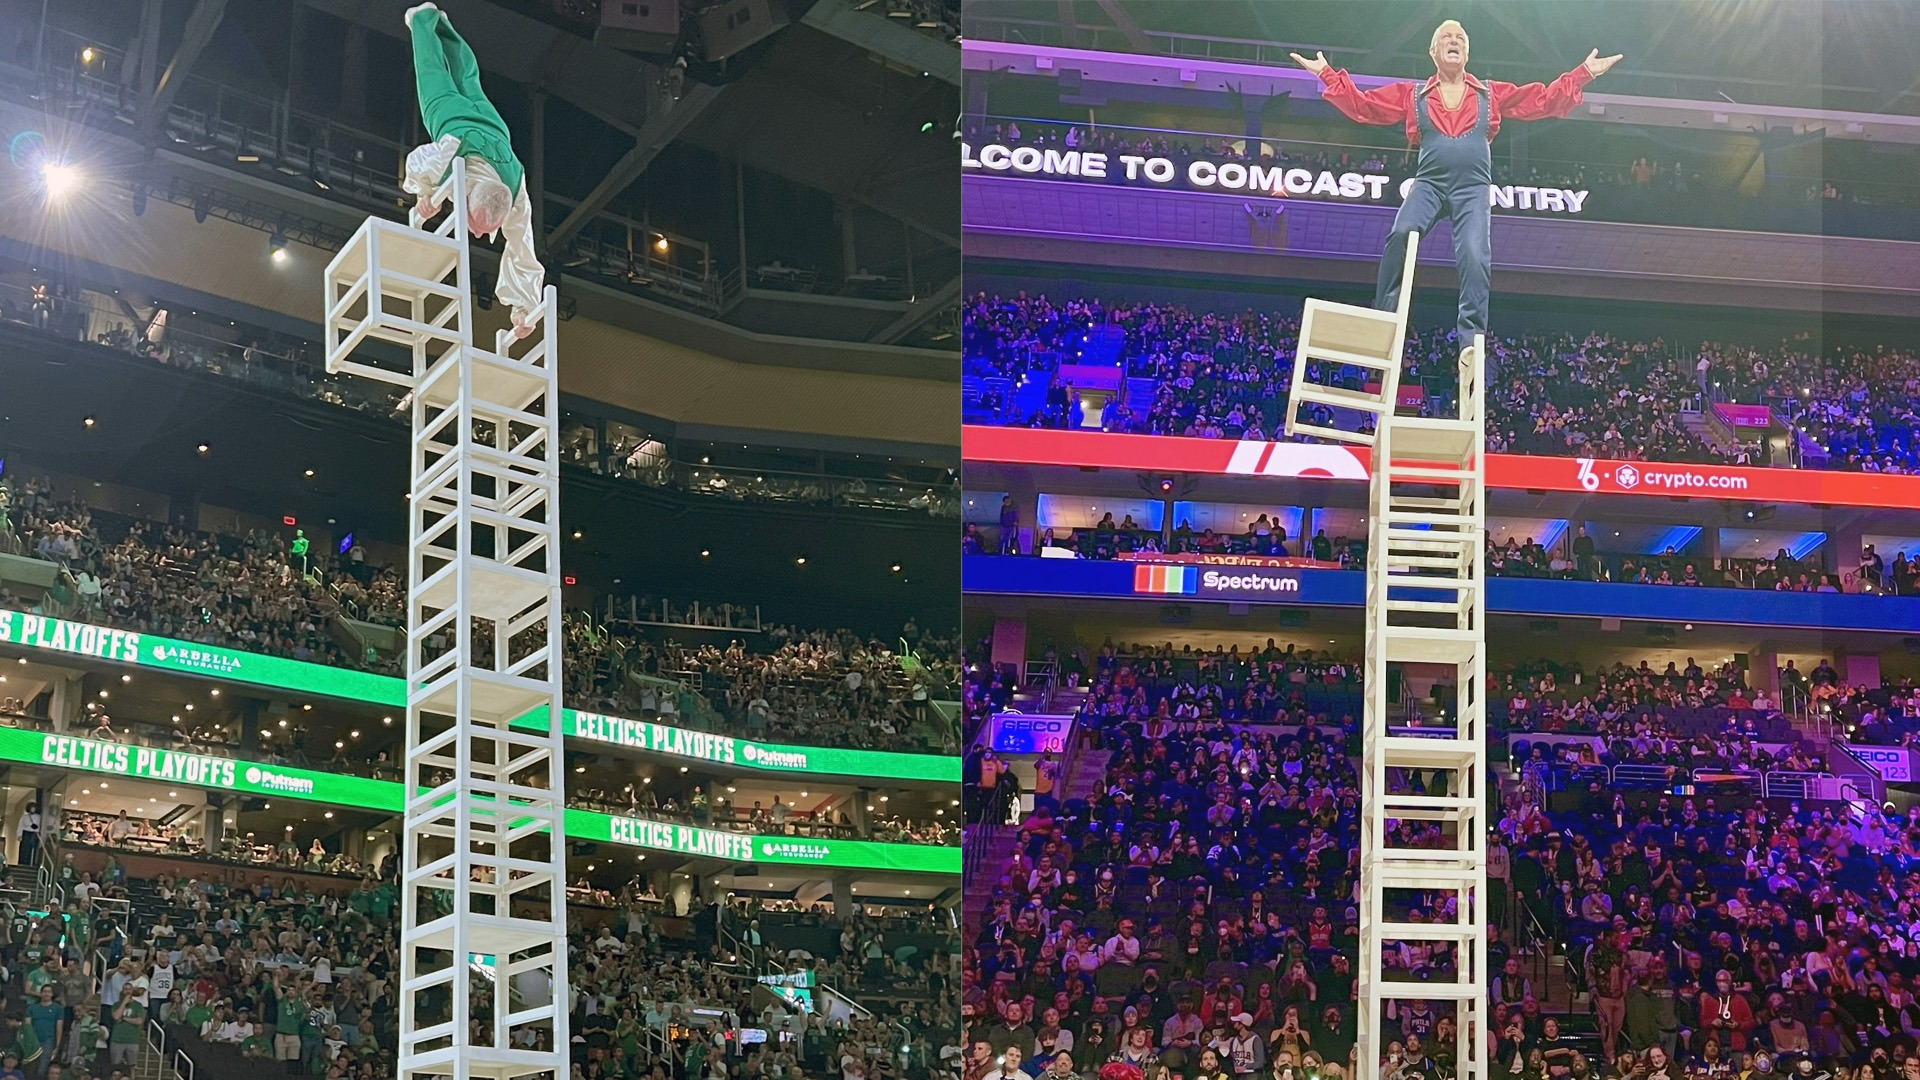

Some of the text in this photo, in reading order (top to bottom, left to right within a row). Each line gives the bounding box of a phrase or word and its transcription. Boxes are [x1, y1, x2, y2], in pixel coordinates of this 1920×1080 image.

[1119, 155, 1175, 182] TO
[1188, 161, 1390, 199] COMCAST
[1406, 397, 1421, 405] 224
[1754, 417, 1769, 425] 223
[1644, 472, 1748, 489] crypto.com
[1203, 571, 1298, 592] Spectrum
[20, 616, 140, 662] PLAYOFFS
[167, 647, 242, 668] ARBELLA
[175, 658, 233, 673] INSURANCE
[1002, 720, 1062, 733] GEICO
[574, 711, 735, 763] CELTICS PLAYOFFS
[41, 735, 236, 787] CELTICS PLAYOFFS
[757, 748, 807, 763] Putnam
[262, 771, 314, 789] Putnam
[1884, 766, 1908, 779] 123
[610, 816, 753, 860] CELTICS PLAYOFFS
[773, 843, 830, 854] ARBELLA
[158, 980, 170, 989] 36
